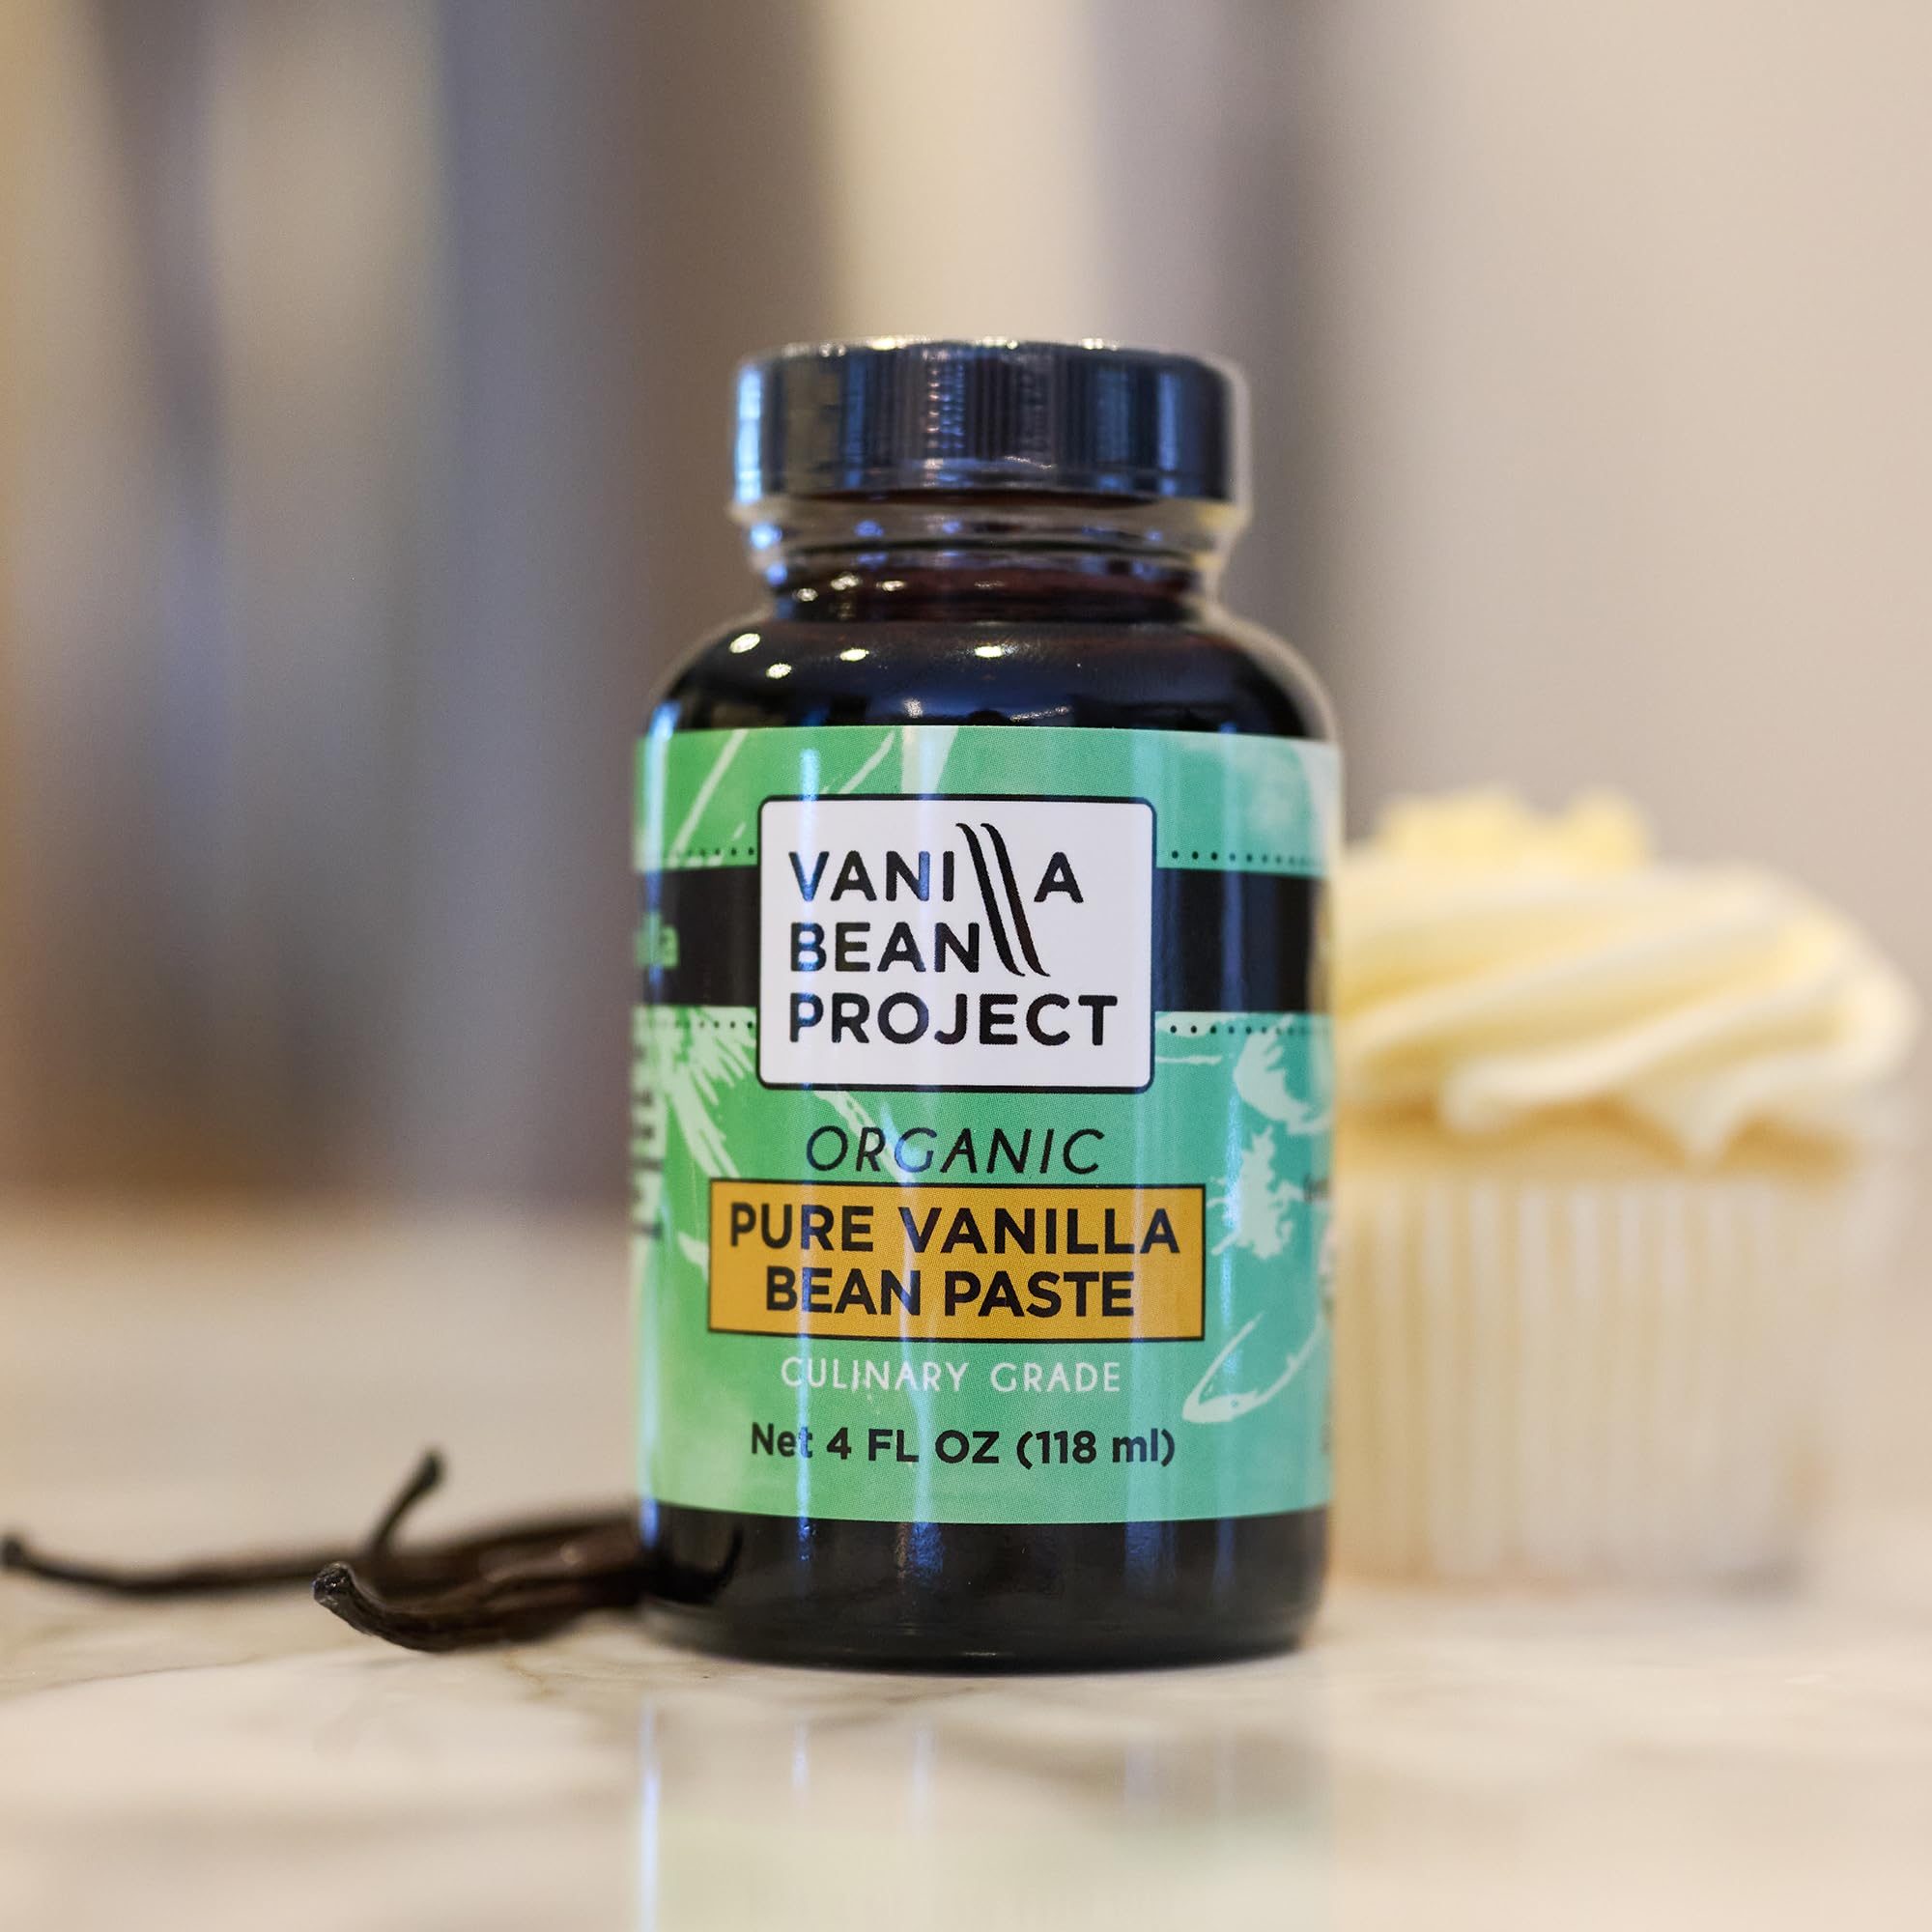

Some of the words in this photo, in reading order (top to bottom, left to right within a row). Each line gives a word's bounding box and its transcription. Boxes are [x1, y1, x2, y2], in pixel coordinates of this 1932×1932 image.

[788, 822, 1084, 978] VANILLA
[790, 922, 980, 974] BEAN
[789, 991, 1119, 1046] PROJECT
[806, 1124, 1105, 1176] ORGANIC
[730, 1202, 874, 1253] PURE
[897, 1207, 1180, 1255] VANILLA
[766, 1267, 922, 1317] BEAN
[944, 1270, 1135, 1319] PASTE
[781, 1356, 968, 1392] CULINARY
[990, 1361, 1120, 1392] GRADE
[752, 1422, 813, 1459] Net
[826, 1426, 852, 1461] 4
[867, 1428, 920, 1463] FL
[934, 1429, 1000, 1464] OZ
[1015, 1430, 1097, 1470] (118
[1112, 1428, 1176, 1467] ml)
